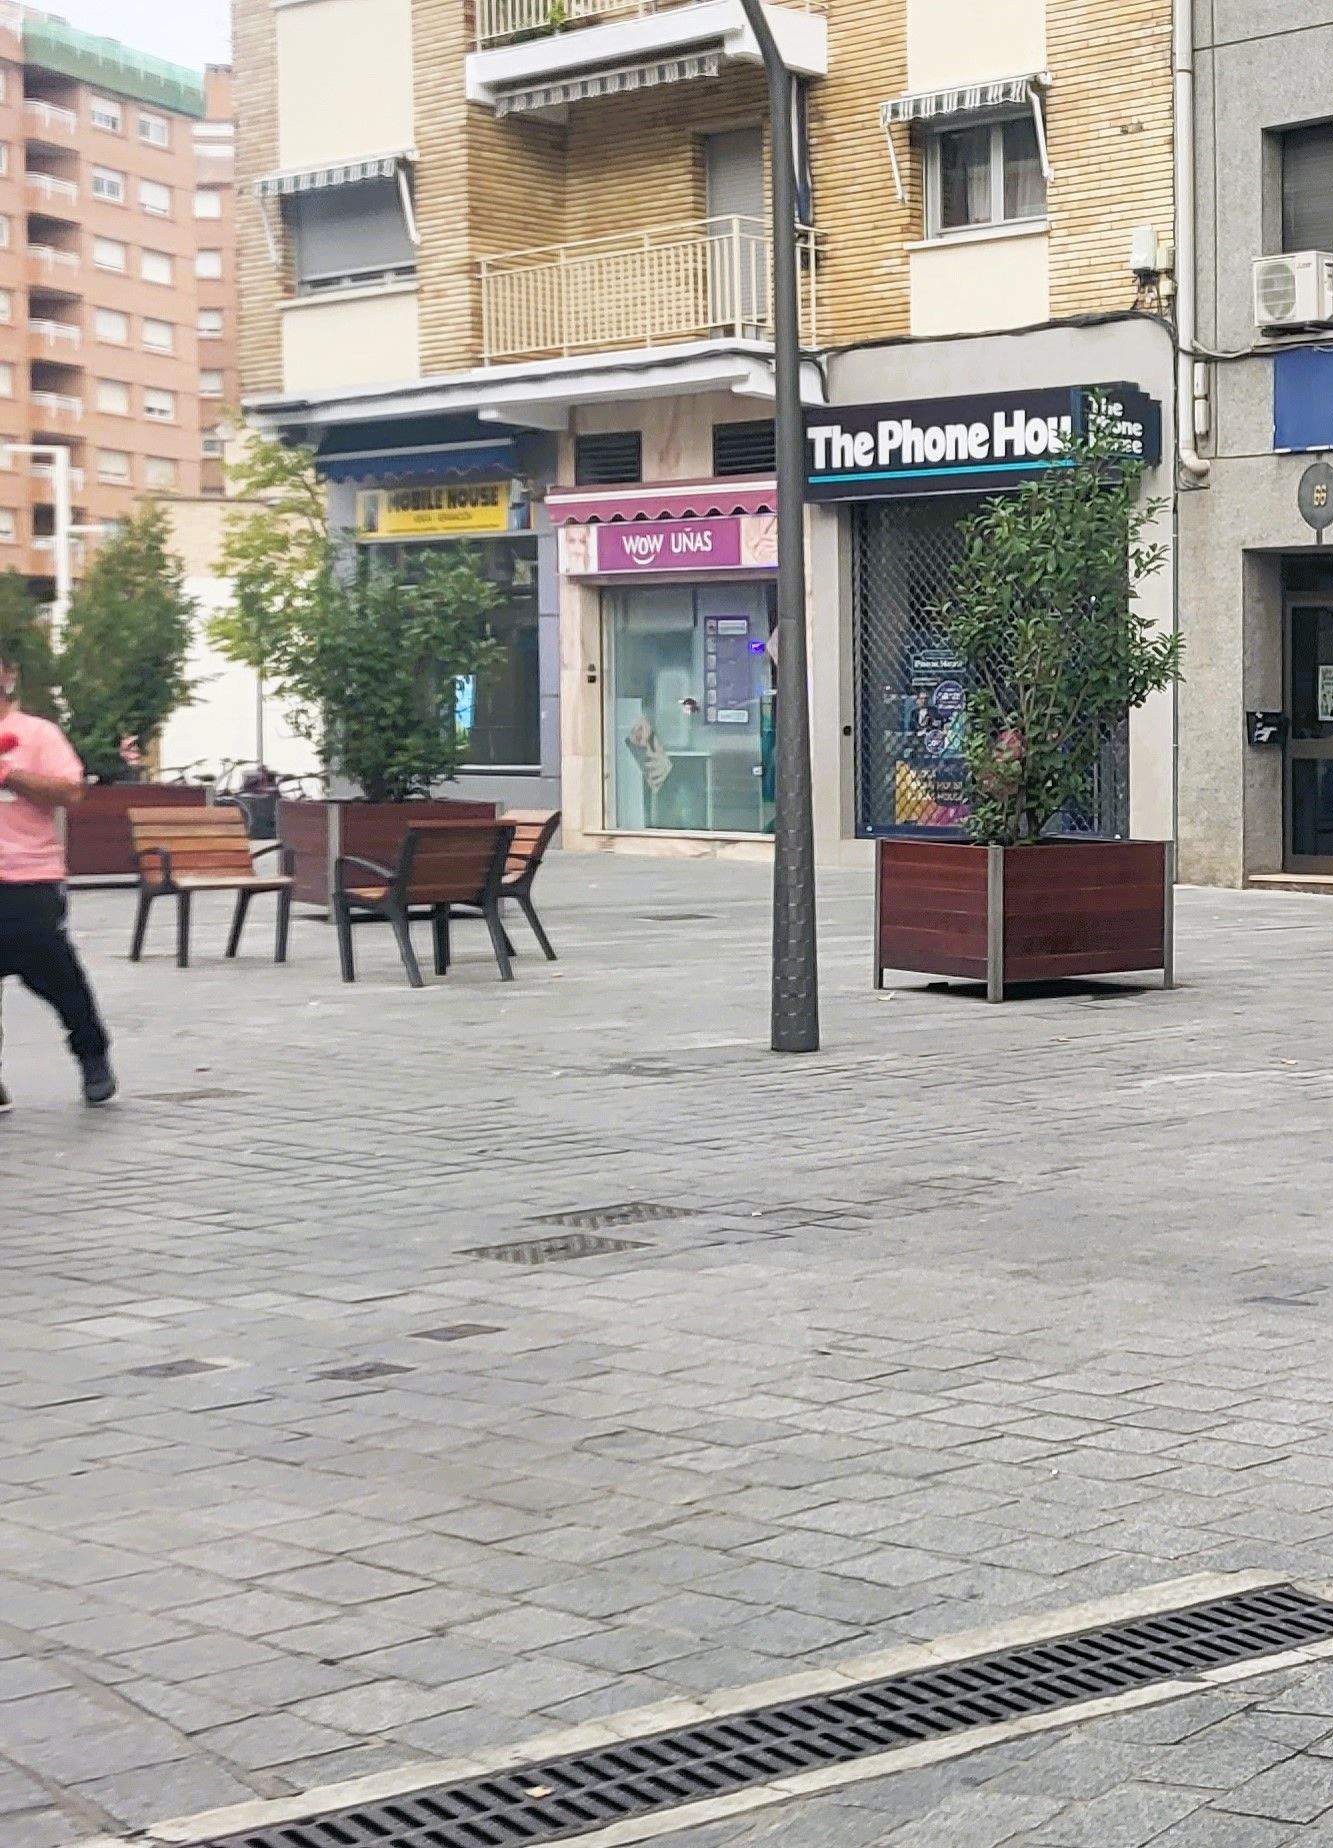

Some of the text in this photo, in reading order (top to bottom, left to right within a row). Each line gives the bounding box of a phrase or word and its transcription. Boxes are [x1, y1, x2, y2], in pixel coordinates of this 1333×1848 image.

[806, 424, 875, 470] The
[876, 418, 990, 466] Phone
[622, 527, 713, 555] WOW UÑAS
